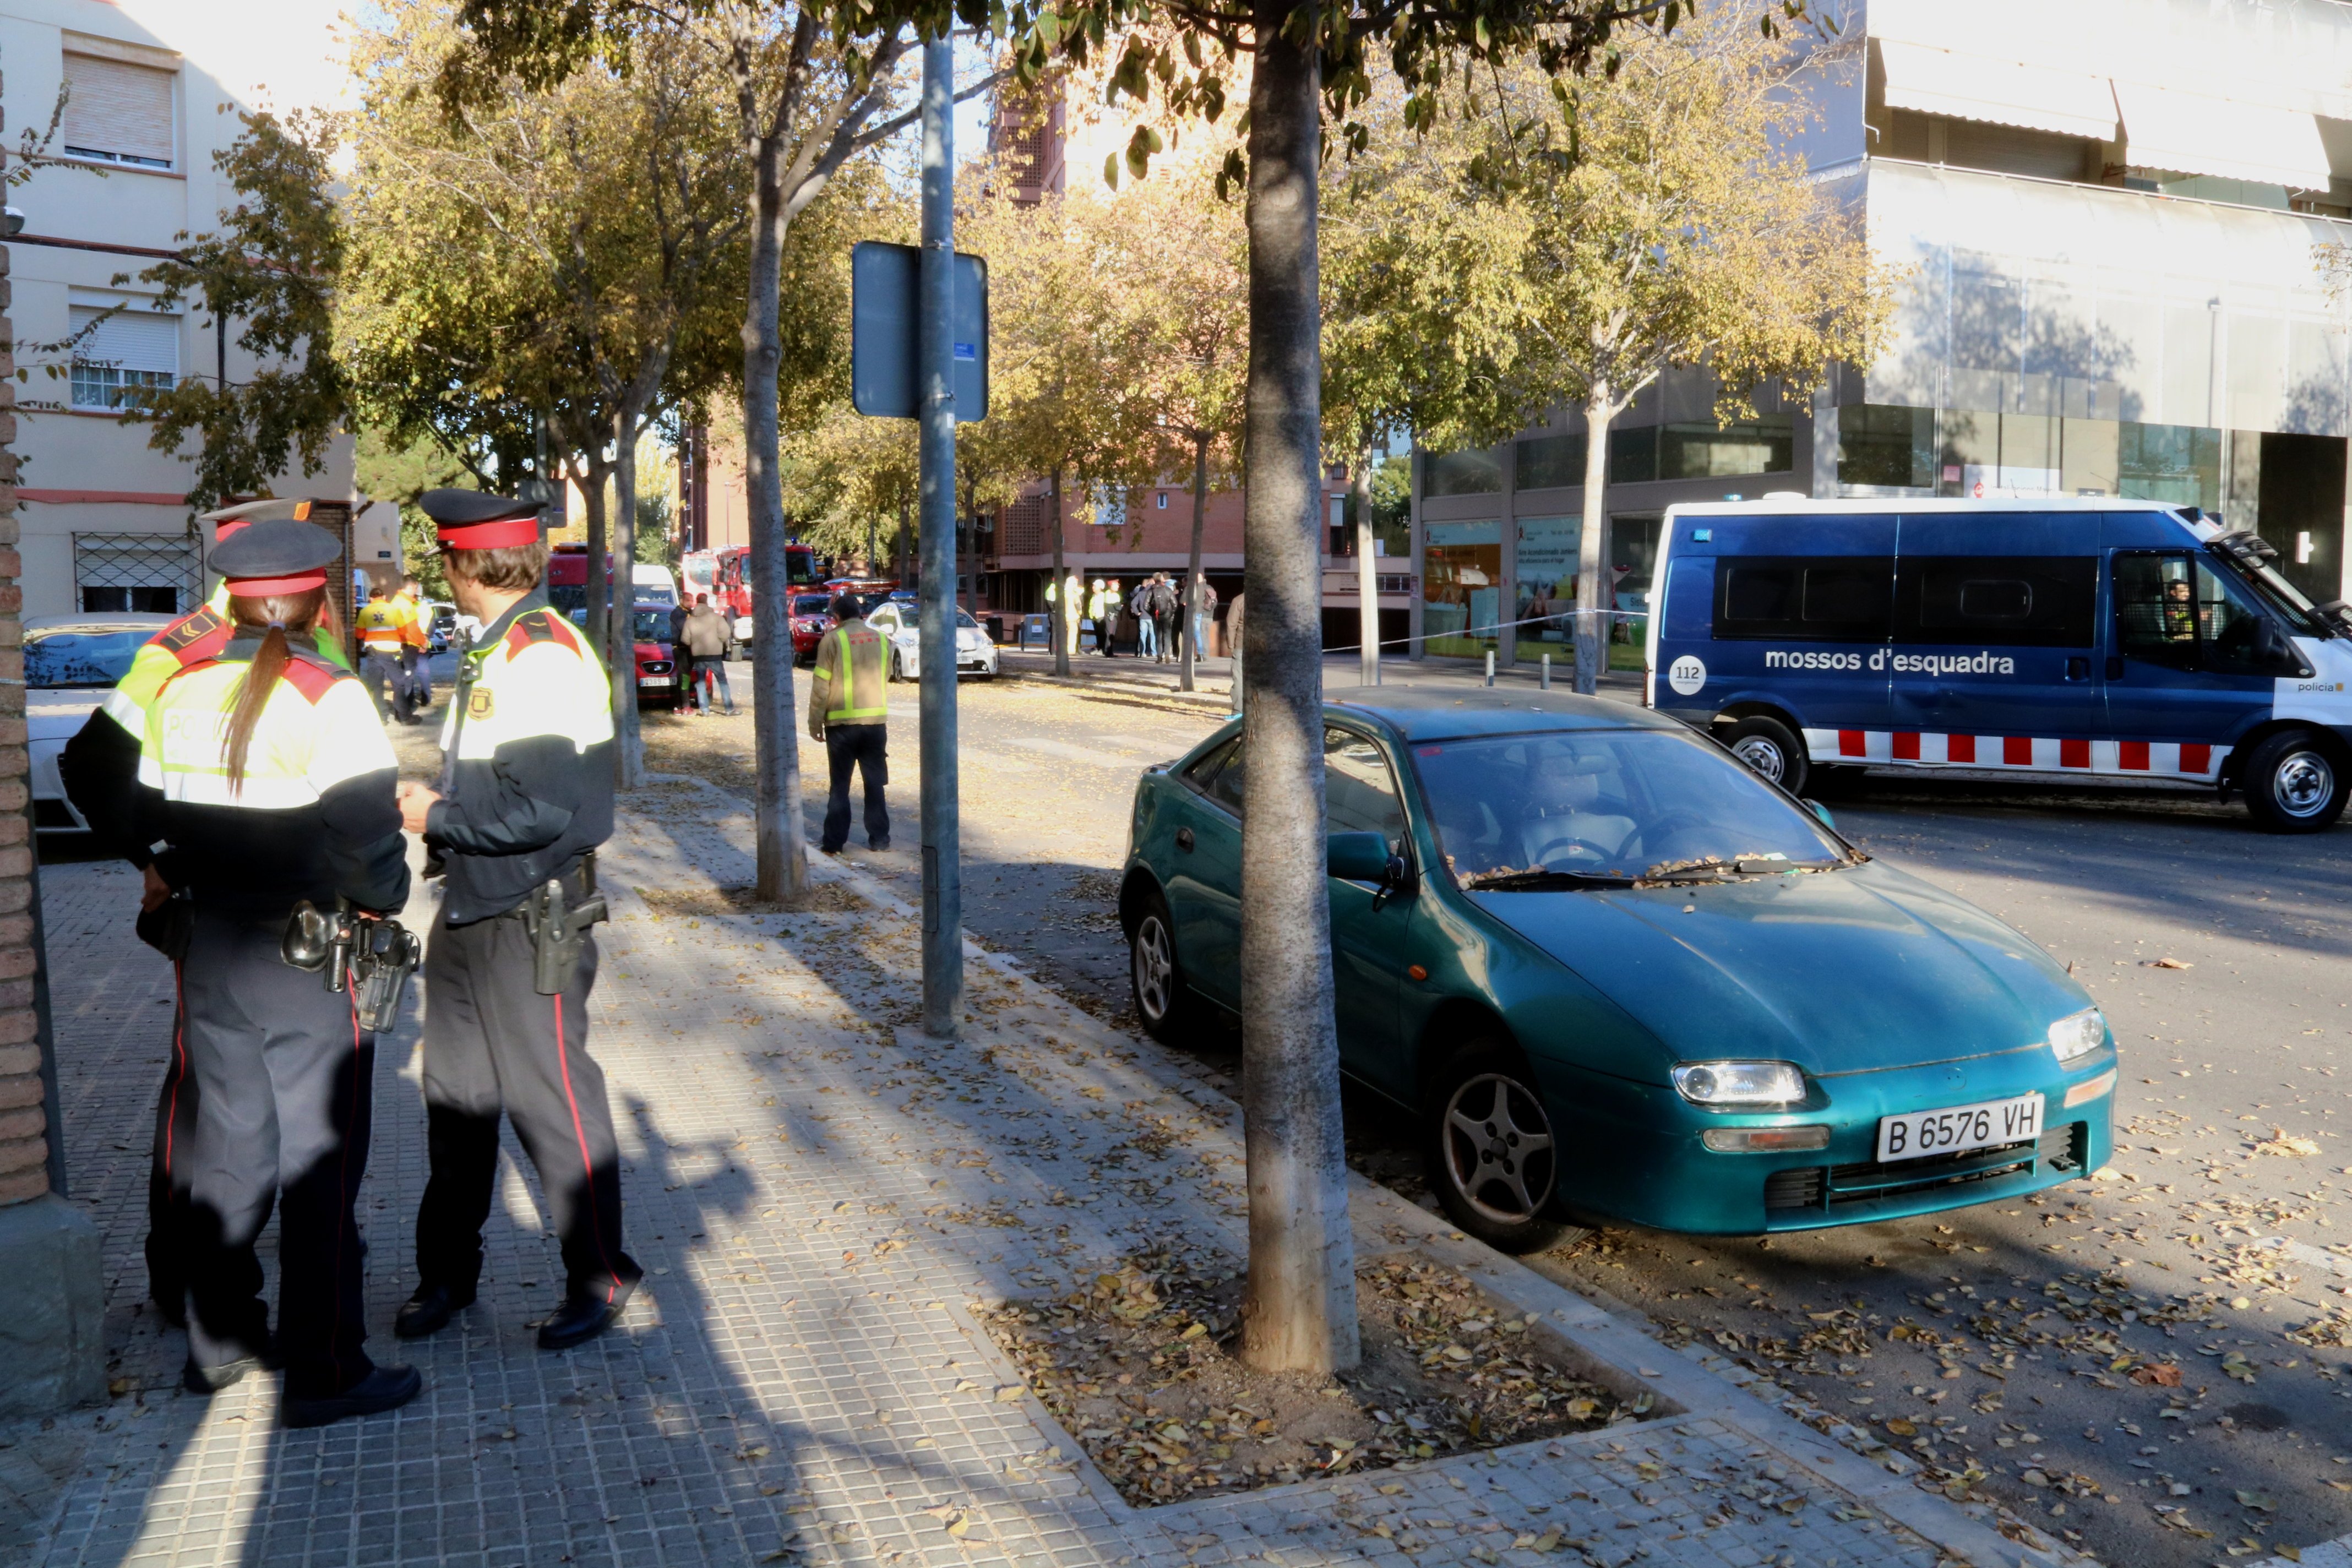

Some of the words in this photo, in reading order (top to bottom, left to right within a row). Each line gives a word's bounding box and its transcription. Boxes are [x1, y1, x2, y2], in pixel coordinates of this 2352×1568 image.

[1766, 651, 1861, 670] mossos
[1676, 667, 1699, 679] 112
[1888, 1121, 1908, 1154] B
[1919, 1109, 1990, 1149] 6576
[2004, 1102, 2035, 1137] VH
